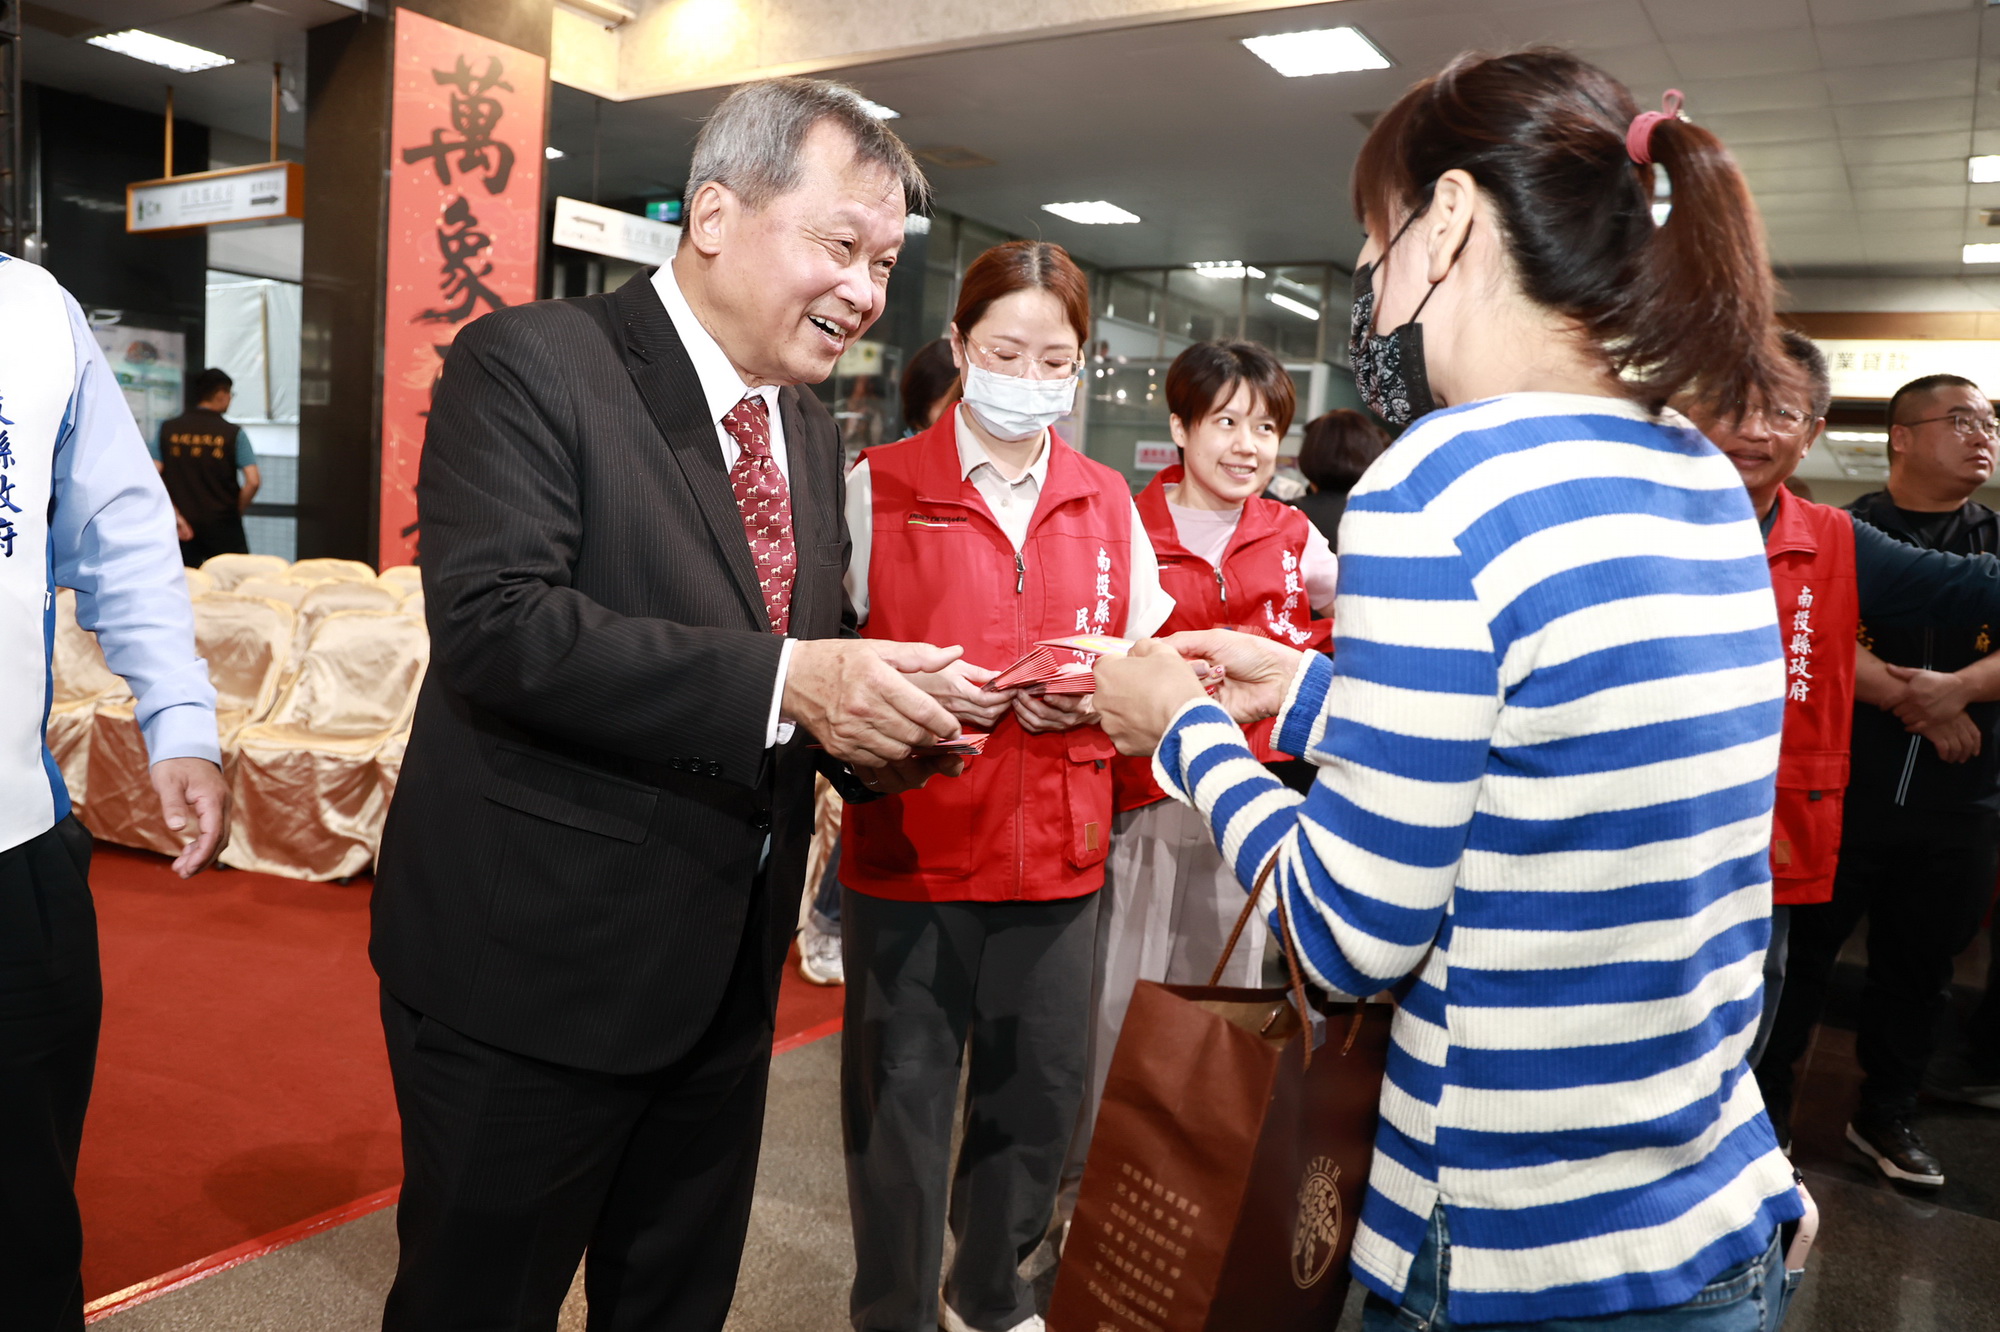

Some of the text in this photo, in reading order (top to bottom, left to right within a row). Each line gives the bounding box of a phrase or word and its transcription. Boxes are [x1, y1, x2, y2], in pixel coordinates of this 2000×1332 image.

[1788, 585, 1815, 702] 南投縣政府
